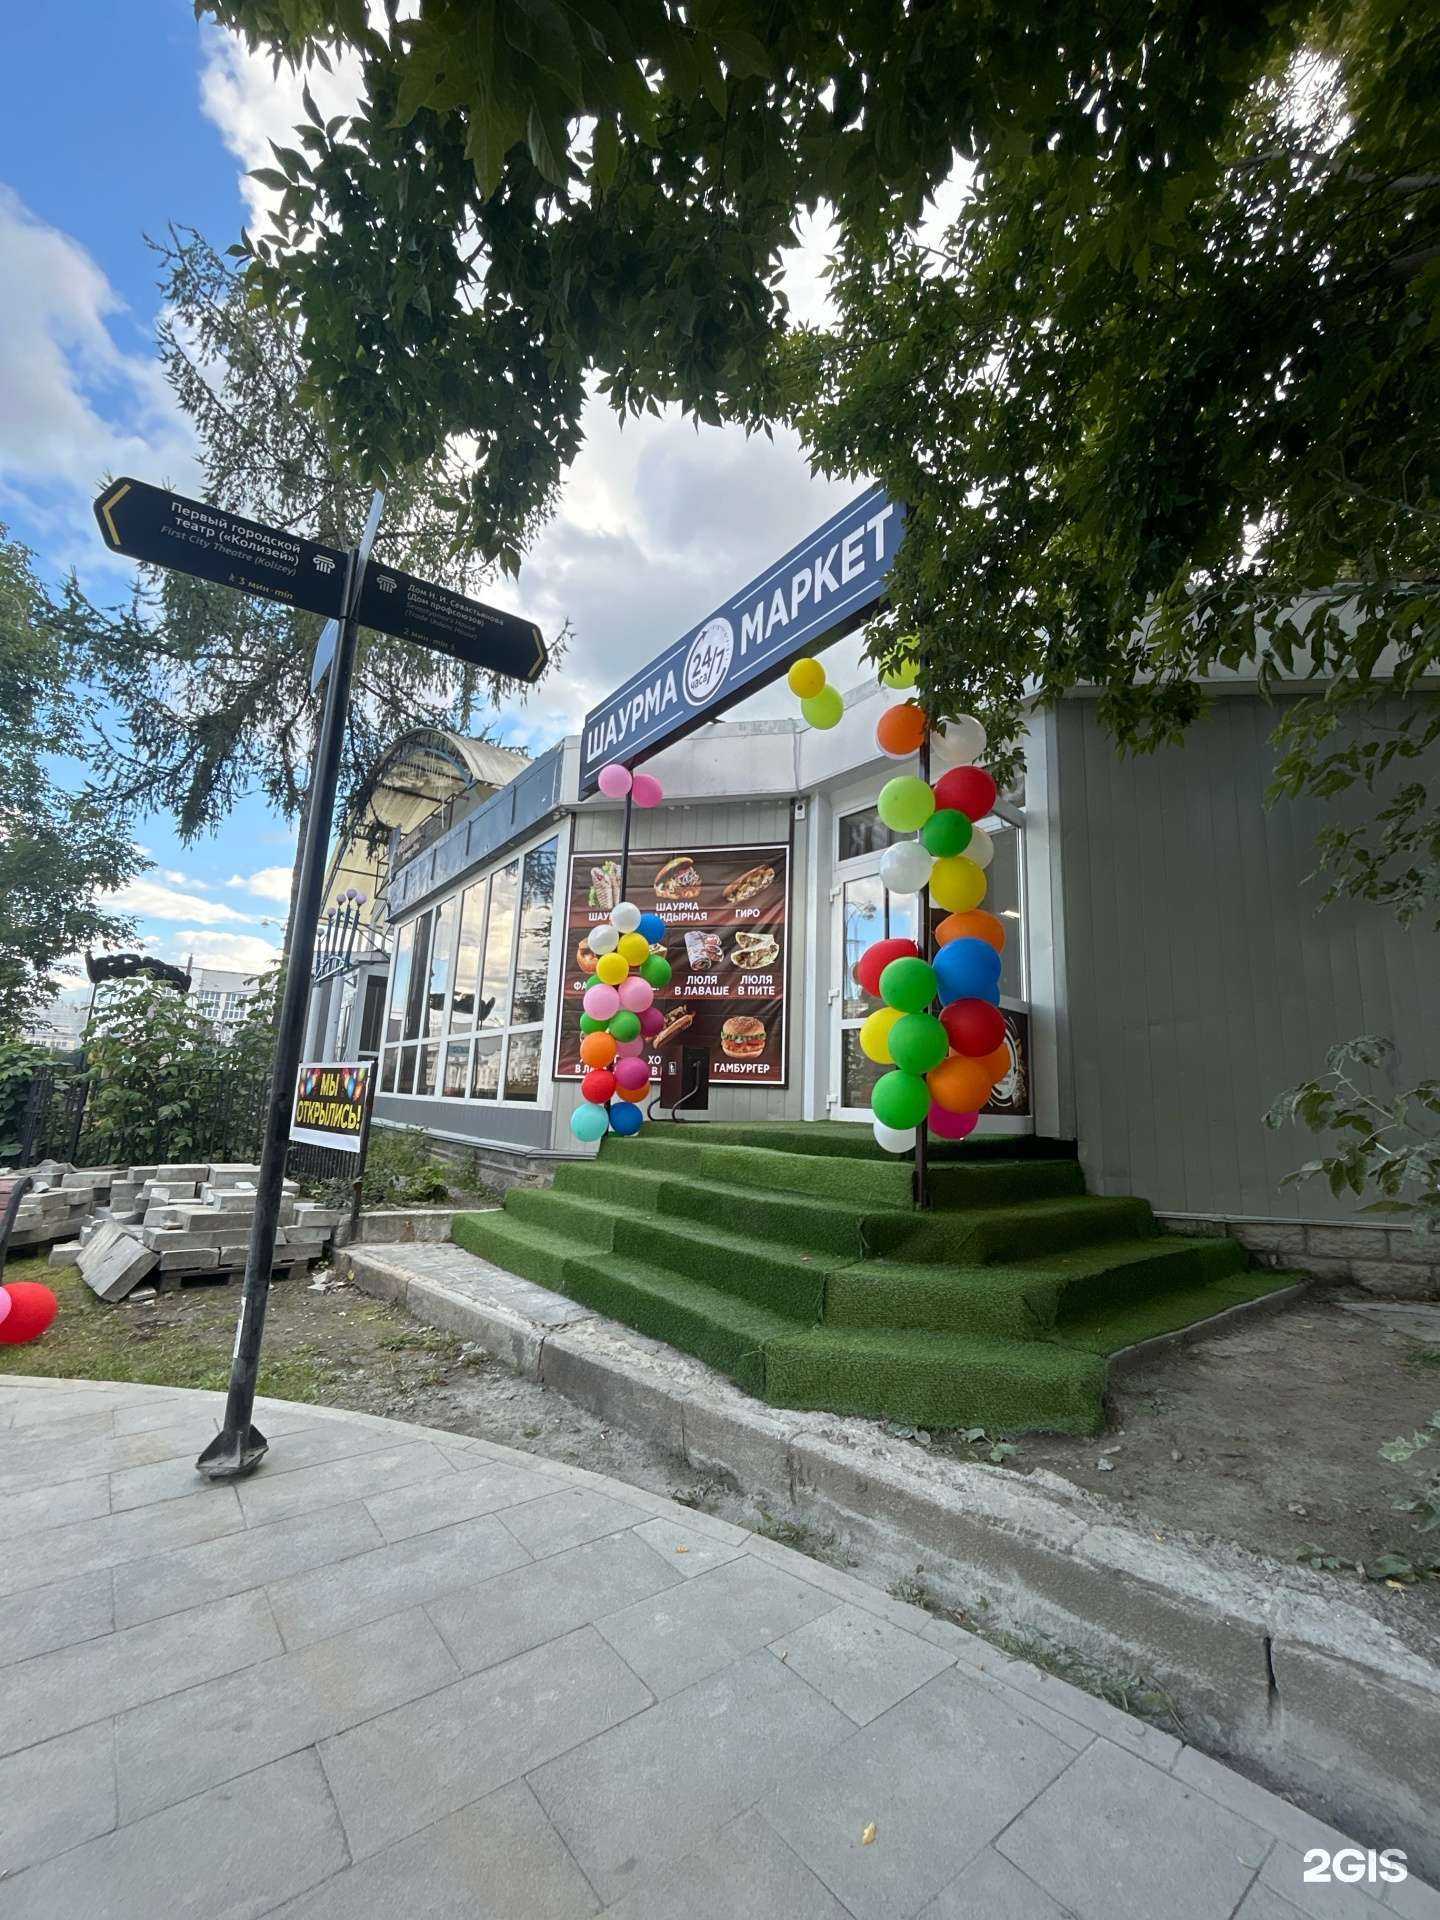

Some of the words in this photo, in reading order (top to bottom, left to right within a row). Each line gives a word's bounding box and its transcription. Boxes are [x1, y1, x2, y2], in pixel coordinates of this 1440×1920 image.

[172, 502, 227, 528] Первый
[232, 525, 300, 553] городской
[175, 517, 215, 537] театр
[219, 531, 299, 566] («Колизей»)
[161, 525, 186, 539] First
[189, 535, 210, 549] City
[214, 542, 253, 560] Theatre
[255, 556, 296, 576] (Kolizey)
[408, 585, 426, 596] Дом
[407, 592, 429, 605] (Дом
[430, 601, 484, 627] профсоюзов)
[586, 670, 678, 763] ШАУРМА
[740, 503, 894, 656] МАРКЕТ
[692, 645, 725, 684] 24/7
[656, 902, 699, 911] ШАУРМА
[656, 912, 708, 922] НДЫРНАЯ
[735, 908, 760, 918] ГИРО
[686, 975, 718, 985] ЛЮЛЯ
[740, 975, 773, 985] ЛЮЛЯ
[675, 987, 681, 996] В
[684, 986, 729, 996] ЛАВАШЕ
[738, 987, 745, 996] В
[748, 986, 775, 996] ПИТЕ
[714, 1062, 770, 1074] ГАМБУРГЕР
[320, 1073, 340, 1096] МЫ
[296, 1100, 362, 1130] ОТКРЫЛИСЬ!
